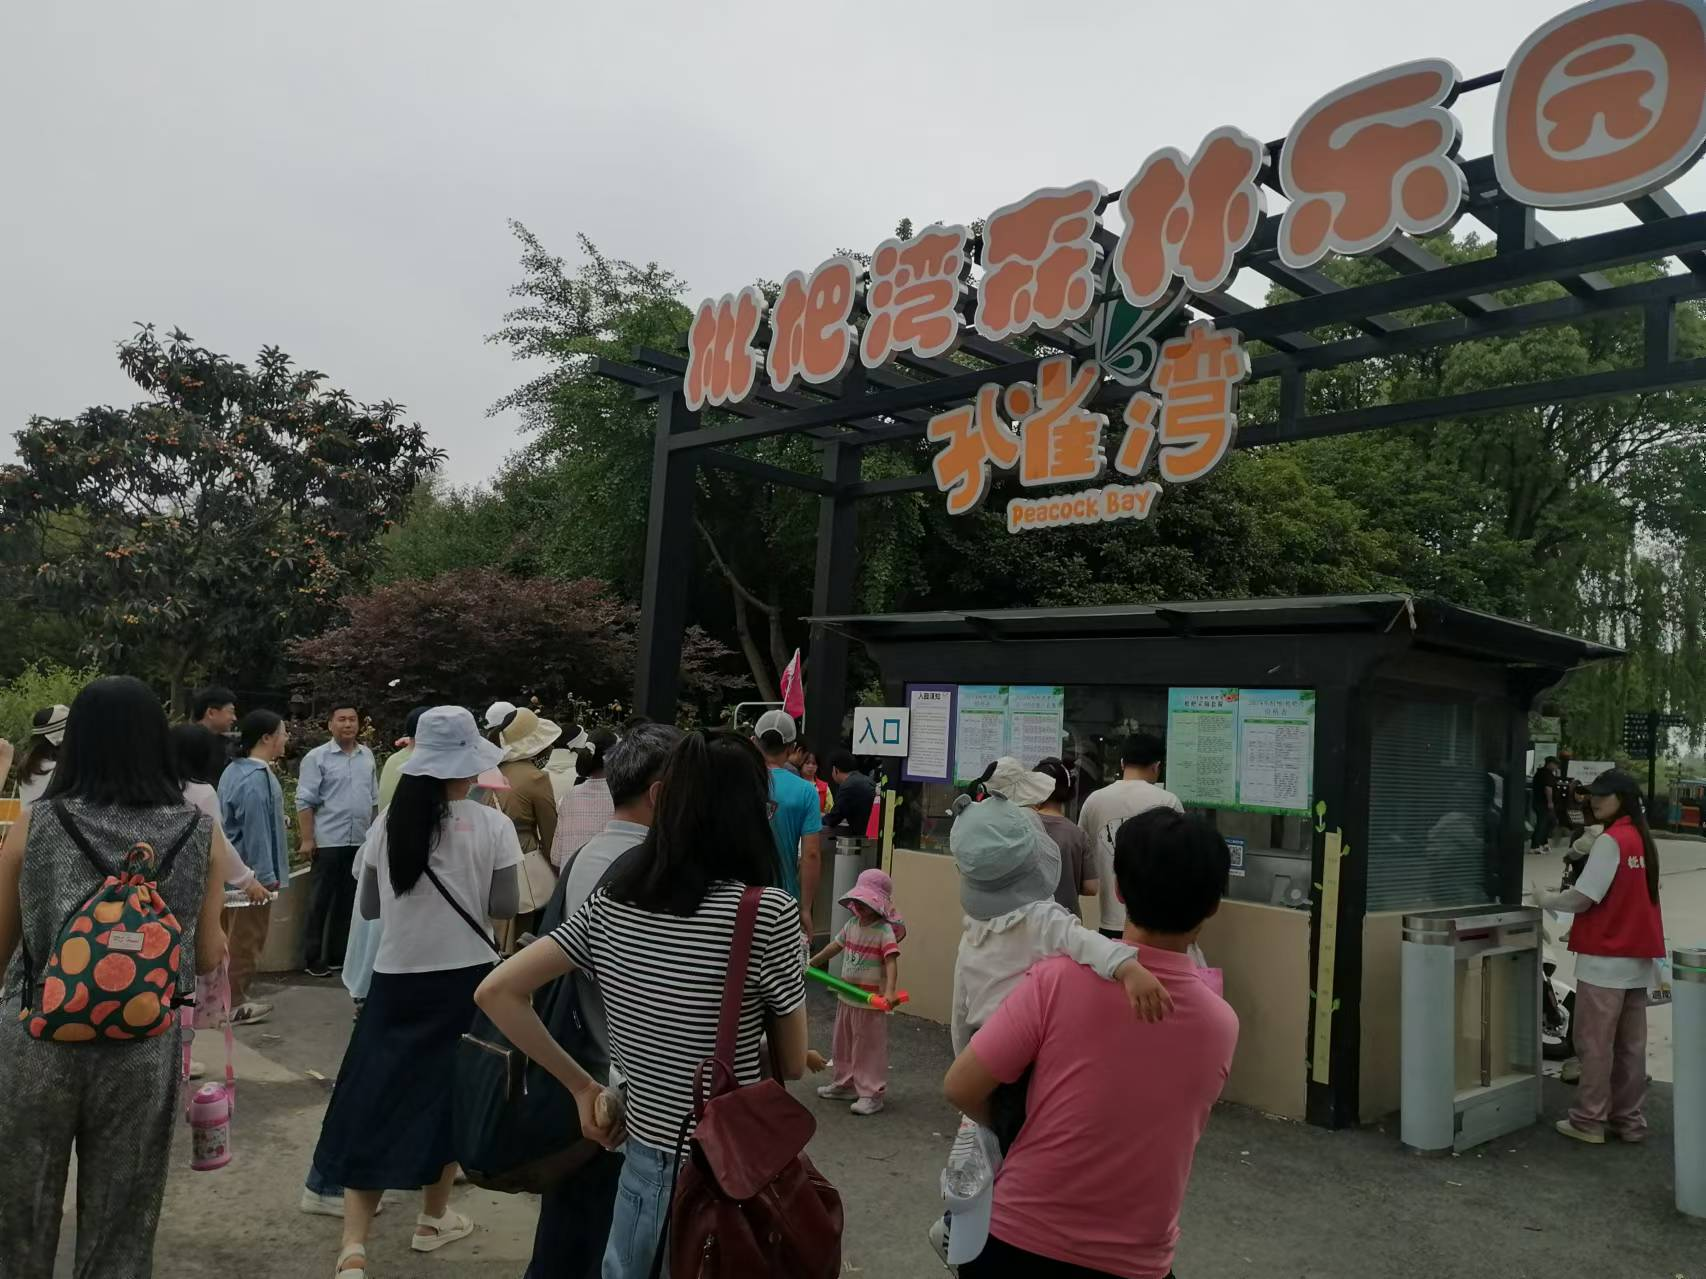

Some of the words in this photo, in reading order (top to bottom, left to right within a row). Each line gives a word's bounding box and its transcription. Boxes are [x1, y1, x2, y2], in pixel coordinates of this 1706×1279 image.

[686, 2, 1706, 409] 枇杷湾森林乐园
[930, 324, 1243, 513] 孔雀湾
[1106, 489, 1150, 514] Bay
[859, 716, 901, 744] 入口
